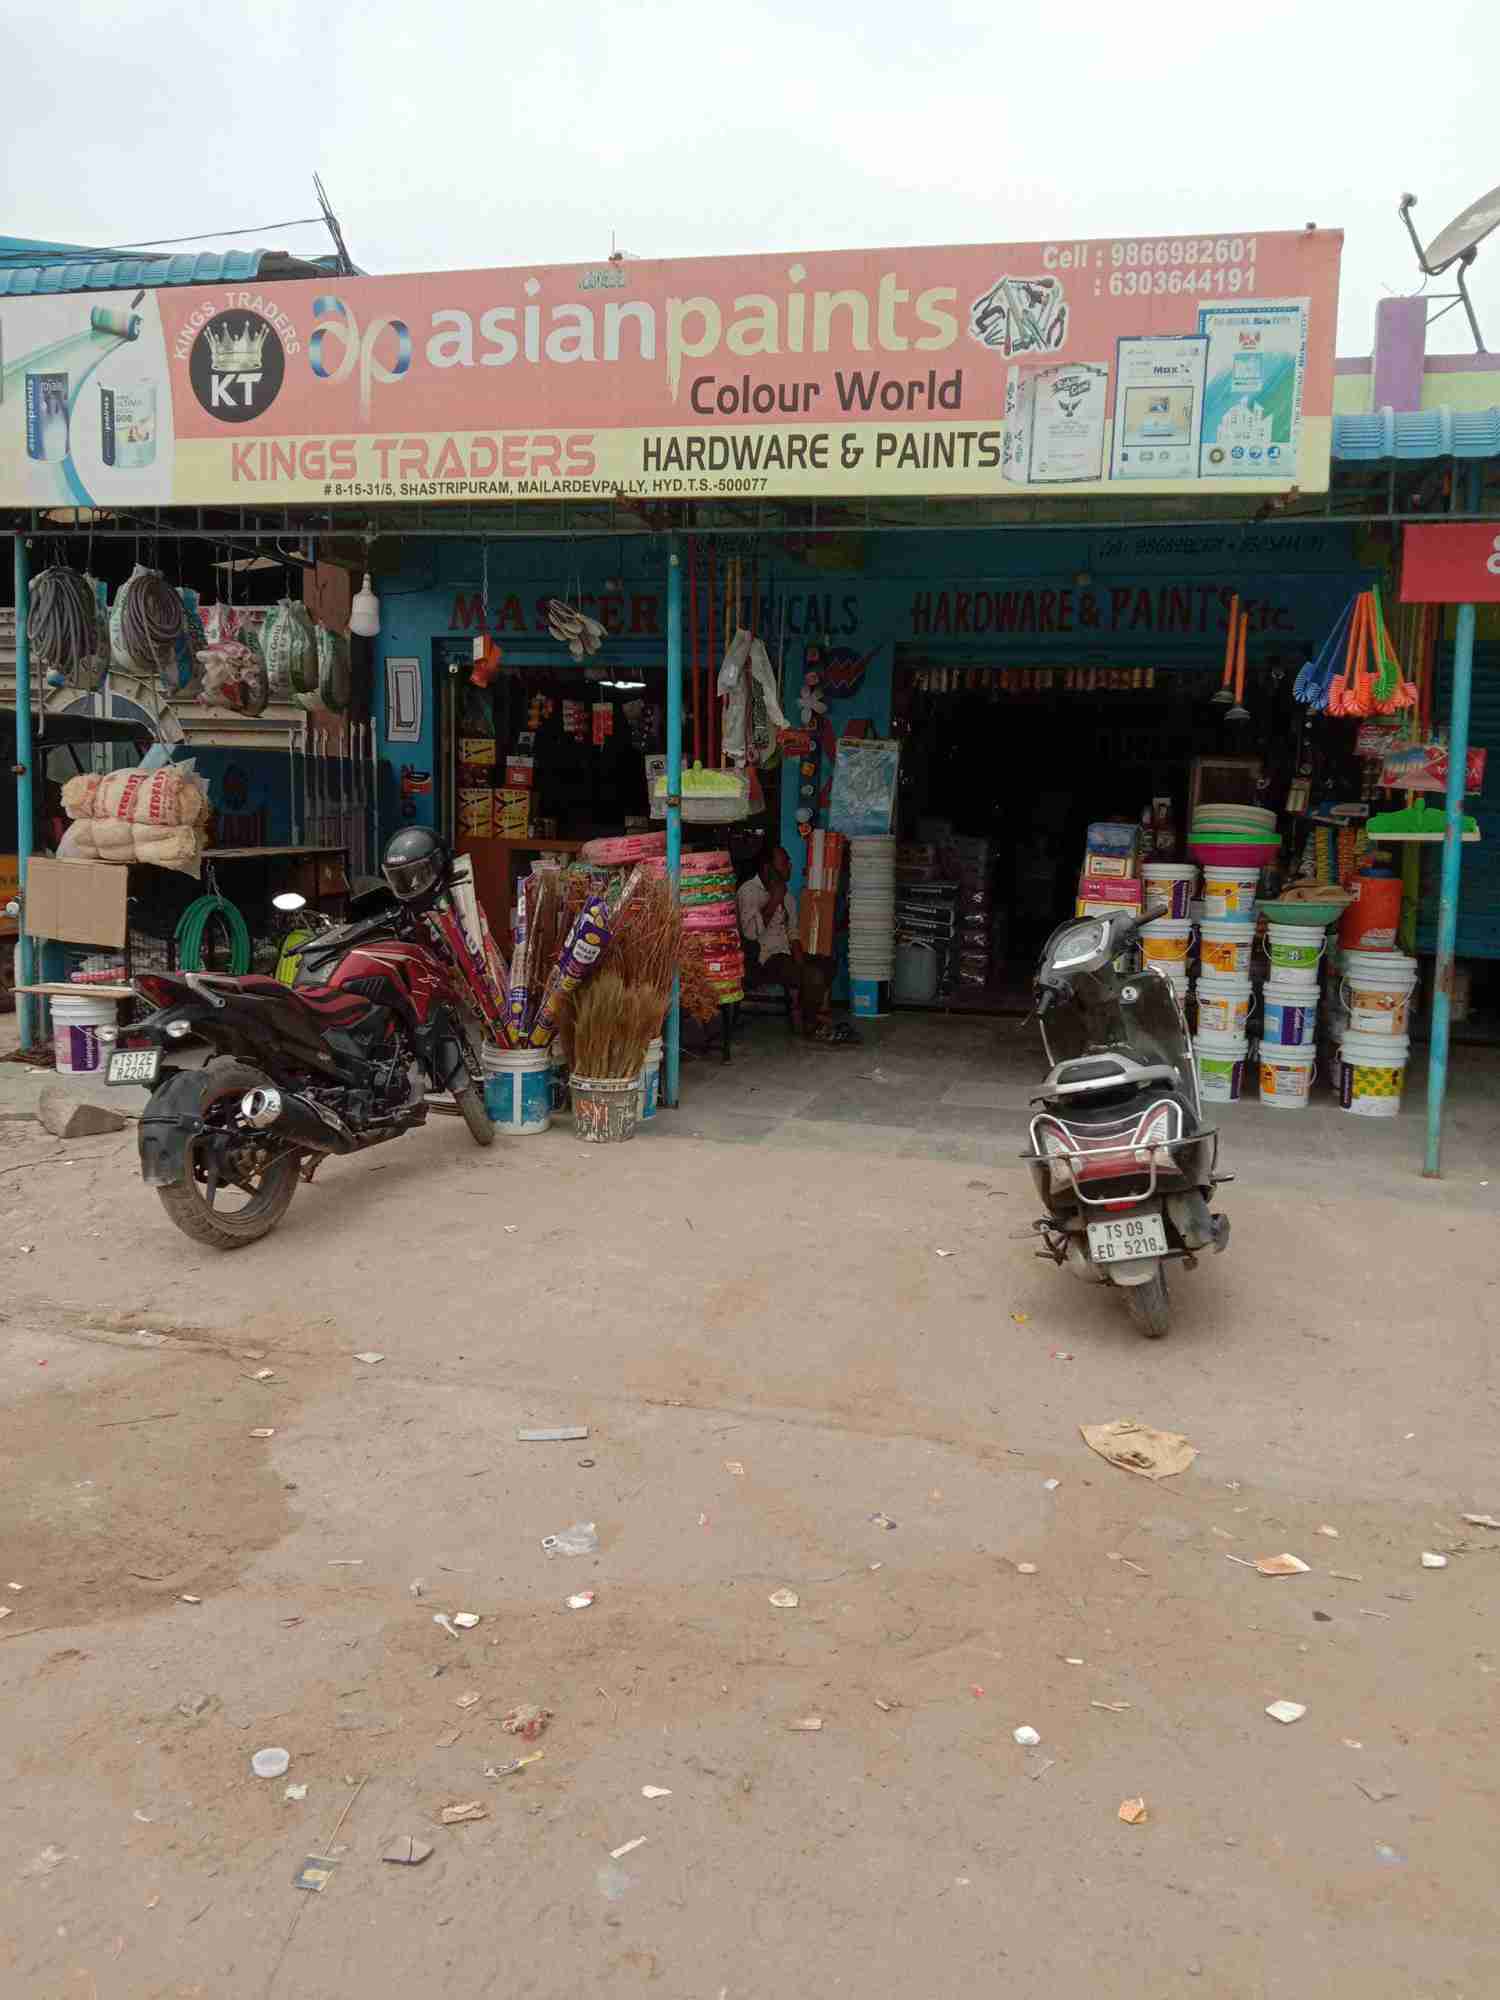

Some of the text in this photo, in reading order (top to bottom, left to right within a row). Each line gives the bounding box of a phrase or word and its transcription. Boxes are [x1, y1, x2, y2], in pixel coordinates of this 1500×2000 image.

[1042, 243, 1088, 269] Cell
[1111, 237, 1257, 267] 9866982601
[1108, 266, 1256, 296] 6303644191
[174, 291, 300, 361] KINGS TRADERS
[211, 372, 263, 407] KT
[690, 369, 963, 415] Colour World
[231, 434, 598, 482] KINGS TRADERS
[642, 431, 1001, 472] HARDWARE & PAINTS
[335, 483, 397, 497] 8-15-31/5,
[400, 480, 513, 496] SHASTRIPURAM,
[517, 478, 648, 495] MAILARDEVPALLY,
[448, 591, 662, 633] MAER
[911, 590, 1073, 633] HARDWARE
[1103, 584, 1240, 633] PAINTS
[1097, 1237, 1157, 1259] ED 5218
[1104, 1220, 1144, 1241] TS 09
